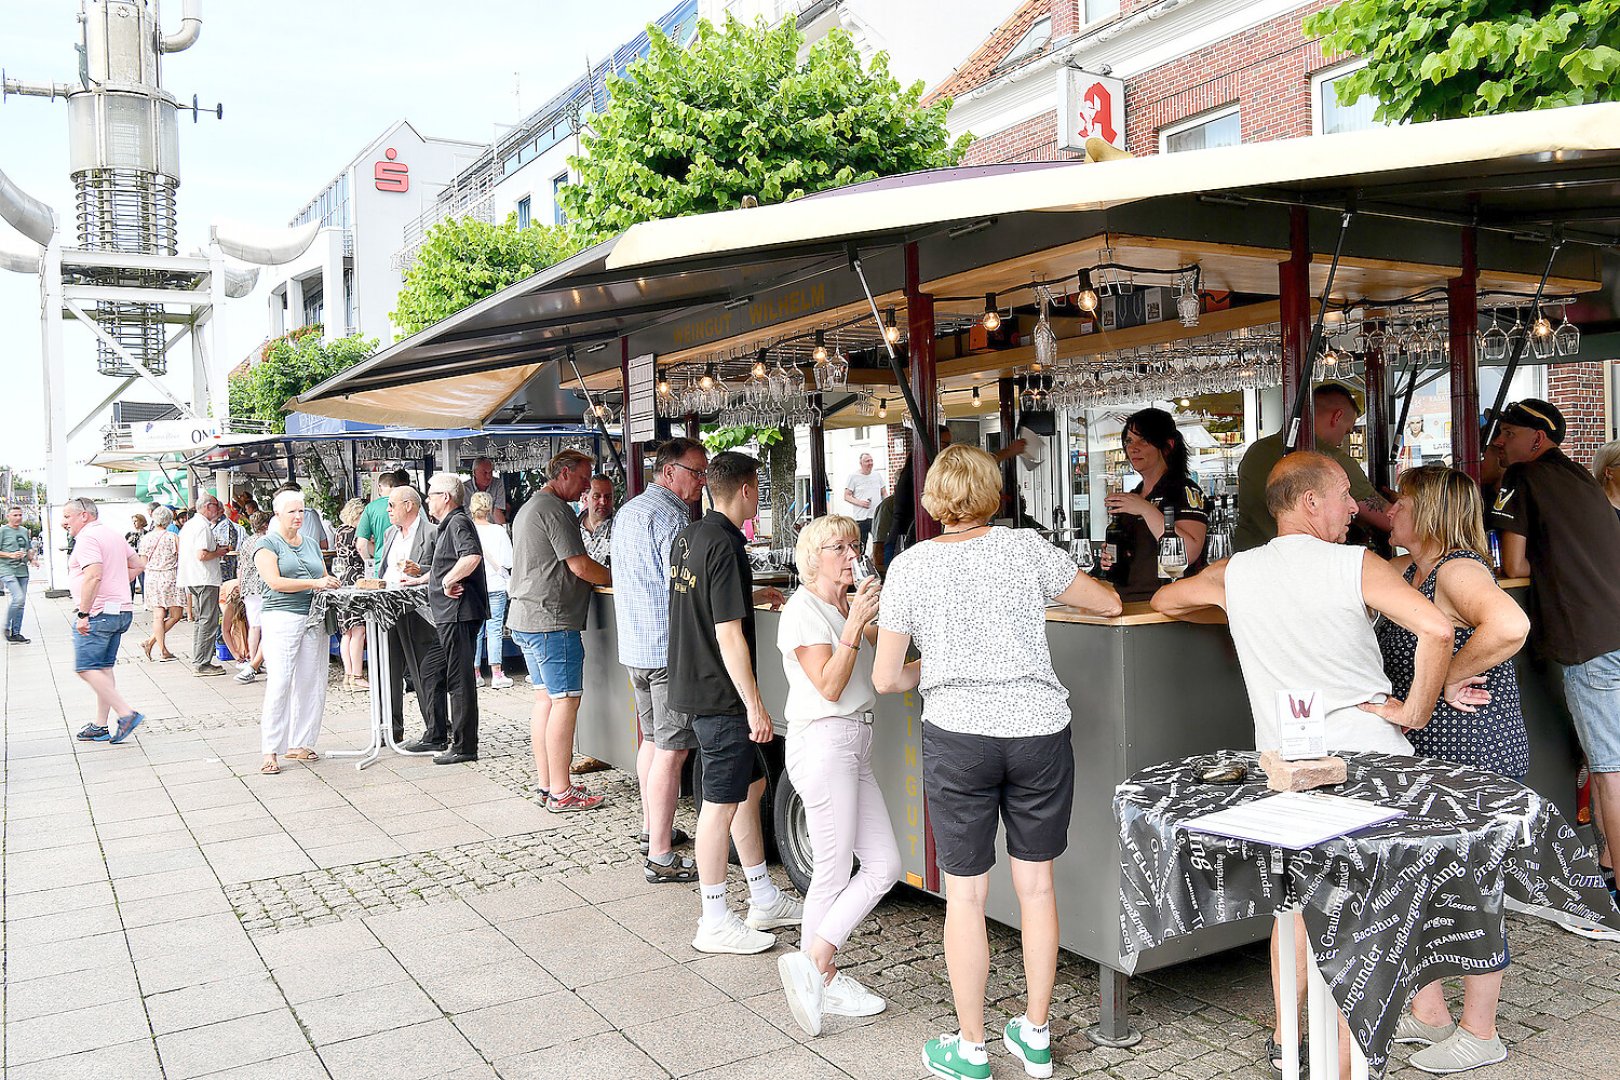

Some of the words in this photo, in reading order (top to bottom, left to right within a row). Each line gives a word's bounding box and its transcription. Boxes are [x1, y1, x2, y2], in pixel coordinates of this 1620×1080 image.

[673, 312, 732, 345] WEINGUT
[750, 282, 826, 325] WILHELM
[1288, 692, 1316, 719] W
[1184, 872, 1198, 910] TRAMINER
[1371, 841, 1444, 914] Müller-Thurgau
[1352, 913, 1400, 943] Bacchus
[1385, 873, 1431, 965] Weißburgunder
[1425, 928, 1487, 950] TRAMINER
